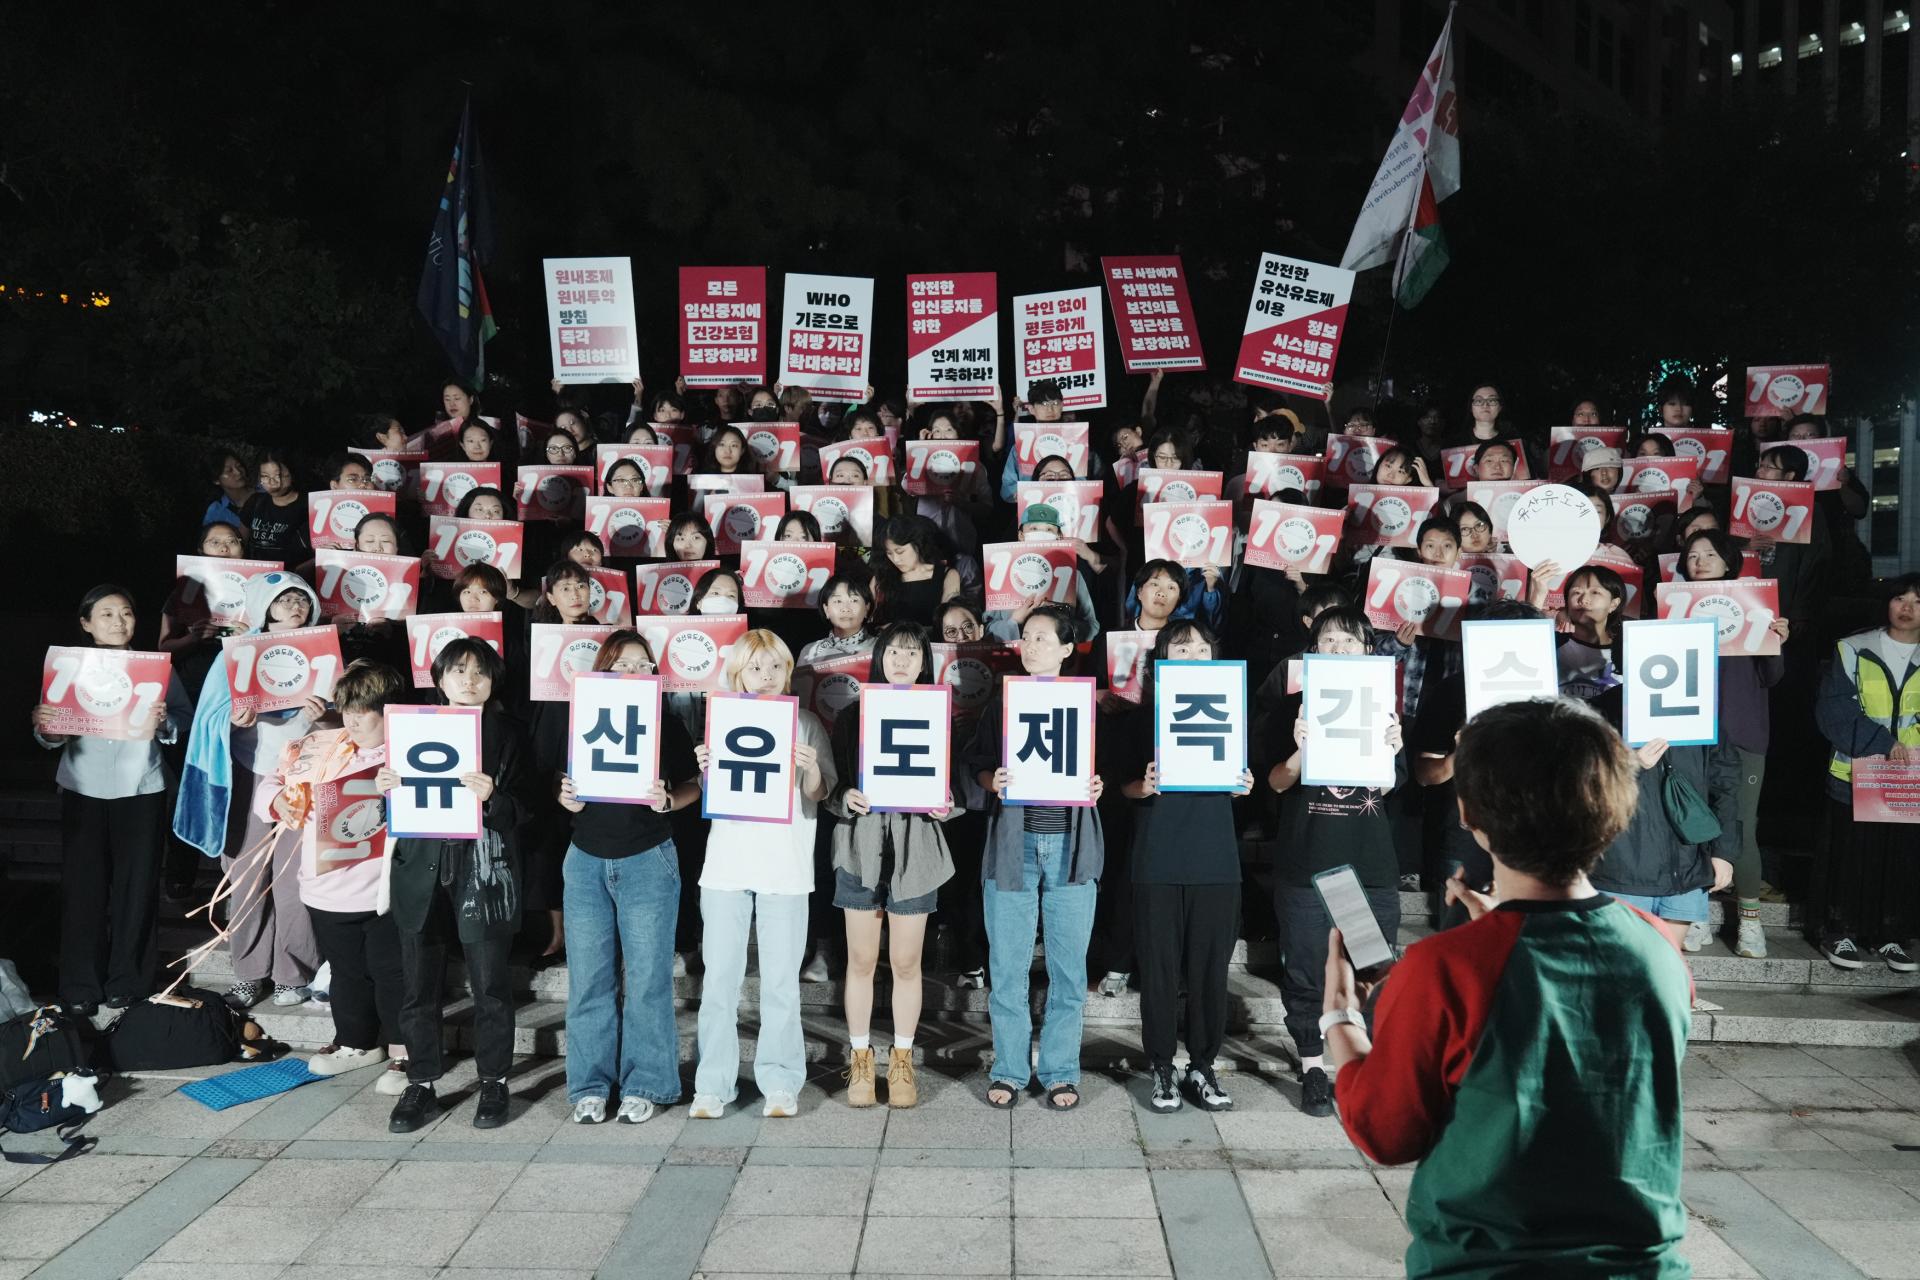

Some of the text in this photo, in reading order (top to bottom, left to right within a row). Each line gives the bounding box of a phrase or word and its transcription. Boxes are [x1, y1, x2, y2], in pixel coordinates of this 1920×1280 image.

[556, 269, 613, 285] 원내조제
[1112, 267, 1178, 279] 모든 사람에게
[1265, 260, 1309, 282] 안전한
[557, 290, 615, 305] 원내투약
[707, 281, 738, 297] 모든
[912, 280, 955, 296] 안전한
[1121, 284, 1175, 297] 차별없는
[1259, 279, 1335, 308] 유산유도제
[807, 291, 851, 307] WHO
[912, 299, 983, 315] 임신중지를
[1025, 297, 1087, 317] 낙인 없이
[1126, 301, 1180, 315] 보건의료
[1255, 299, 1285, 317] 이용
[559, 310, 588, 325] 방침
[684, 303, 761, 319] 임신중지에
[795, 312, 858, 330] 기준으로
[692, 326, 753, 341] 건강보험
[912, 319, 941, 334] 위한
[1025, 317, 1085, 336] 평등하게
[1130, 318, 1184, 333] 접근성을
[1307, 320, 1338, 340] 정보
[561, 330, 591, 345] 즉각
[792, 332, 860, 352] 처방 기간
[1131, 335, 1191, 351] 보장하라!
[1273, 333, 1333, 359] 시스템을
[562, 349, 627, 365] 철회하라!
[688, 347, 757, 364] 보장하라!
[788, 352, 861, 373] 확대하라!
[932, 347, 991, 363] 연계 체계
[1026, 355, 1072, 375] 건강권
[1261, 350, 1330, 377] 구축하라!
[930, 367, 993, 383] 구축하라!
[1748, 372, 1824, 413] 101
[1018, 430, 1086, 469] 101
[1517, 489, 1592, 522] 유산유도제
[1733, 485, 1809, 541] 101
[589, 503, 666, 557] 101
[705, 502, 783, 550] 101
[1149, 510, 1228, 563] 101
[1251, 510, 1337, 570] 101
[744, 549, 831, 605] 101
[988, 551, 1074, 603] 101
[320, 559, 413, 621] 101
[1370, 568, 1463, 636] 101
[231, 644, 338, 703] 101
[1639, 648, 1700, 718] 인
[46, 655, 163, 727] 101
[1169, 693, 1233, 761] 즉
[1316, 686, 1382, 757] 각
[582, 704, 647, 774] 산
[873, 718, 936, 777] 도
[1016, 707, 1079, 777] 제
[717, 724, 781, 793] 유
[402, 740, 465, 809] 유
